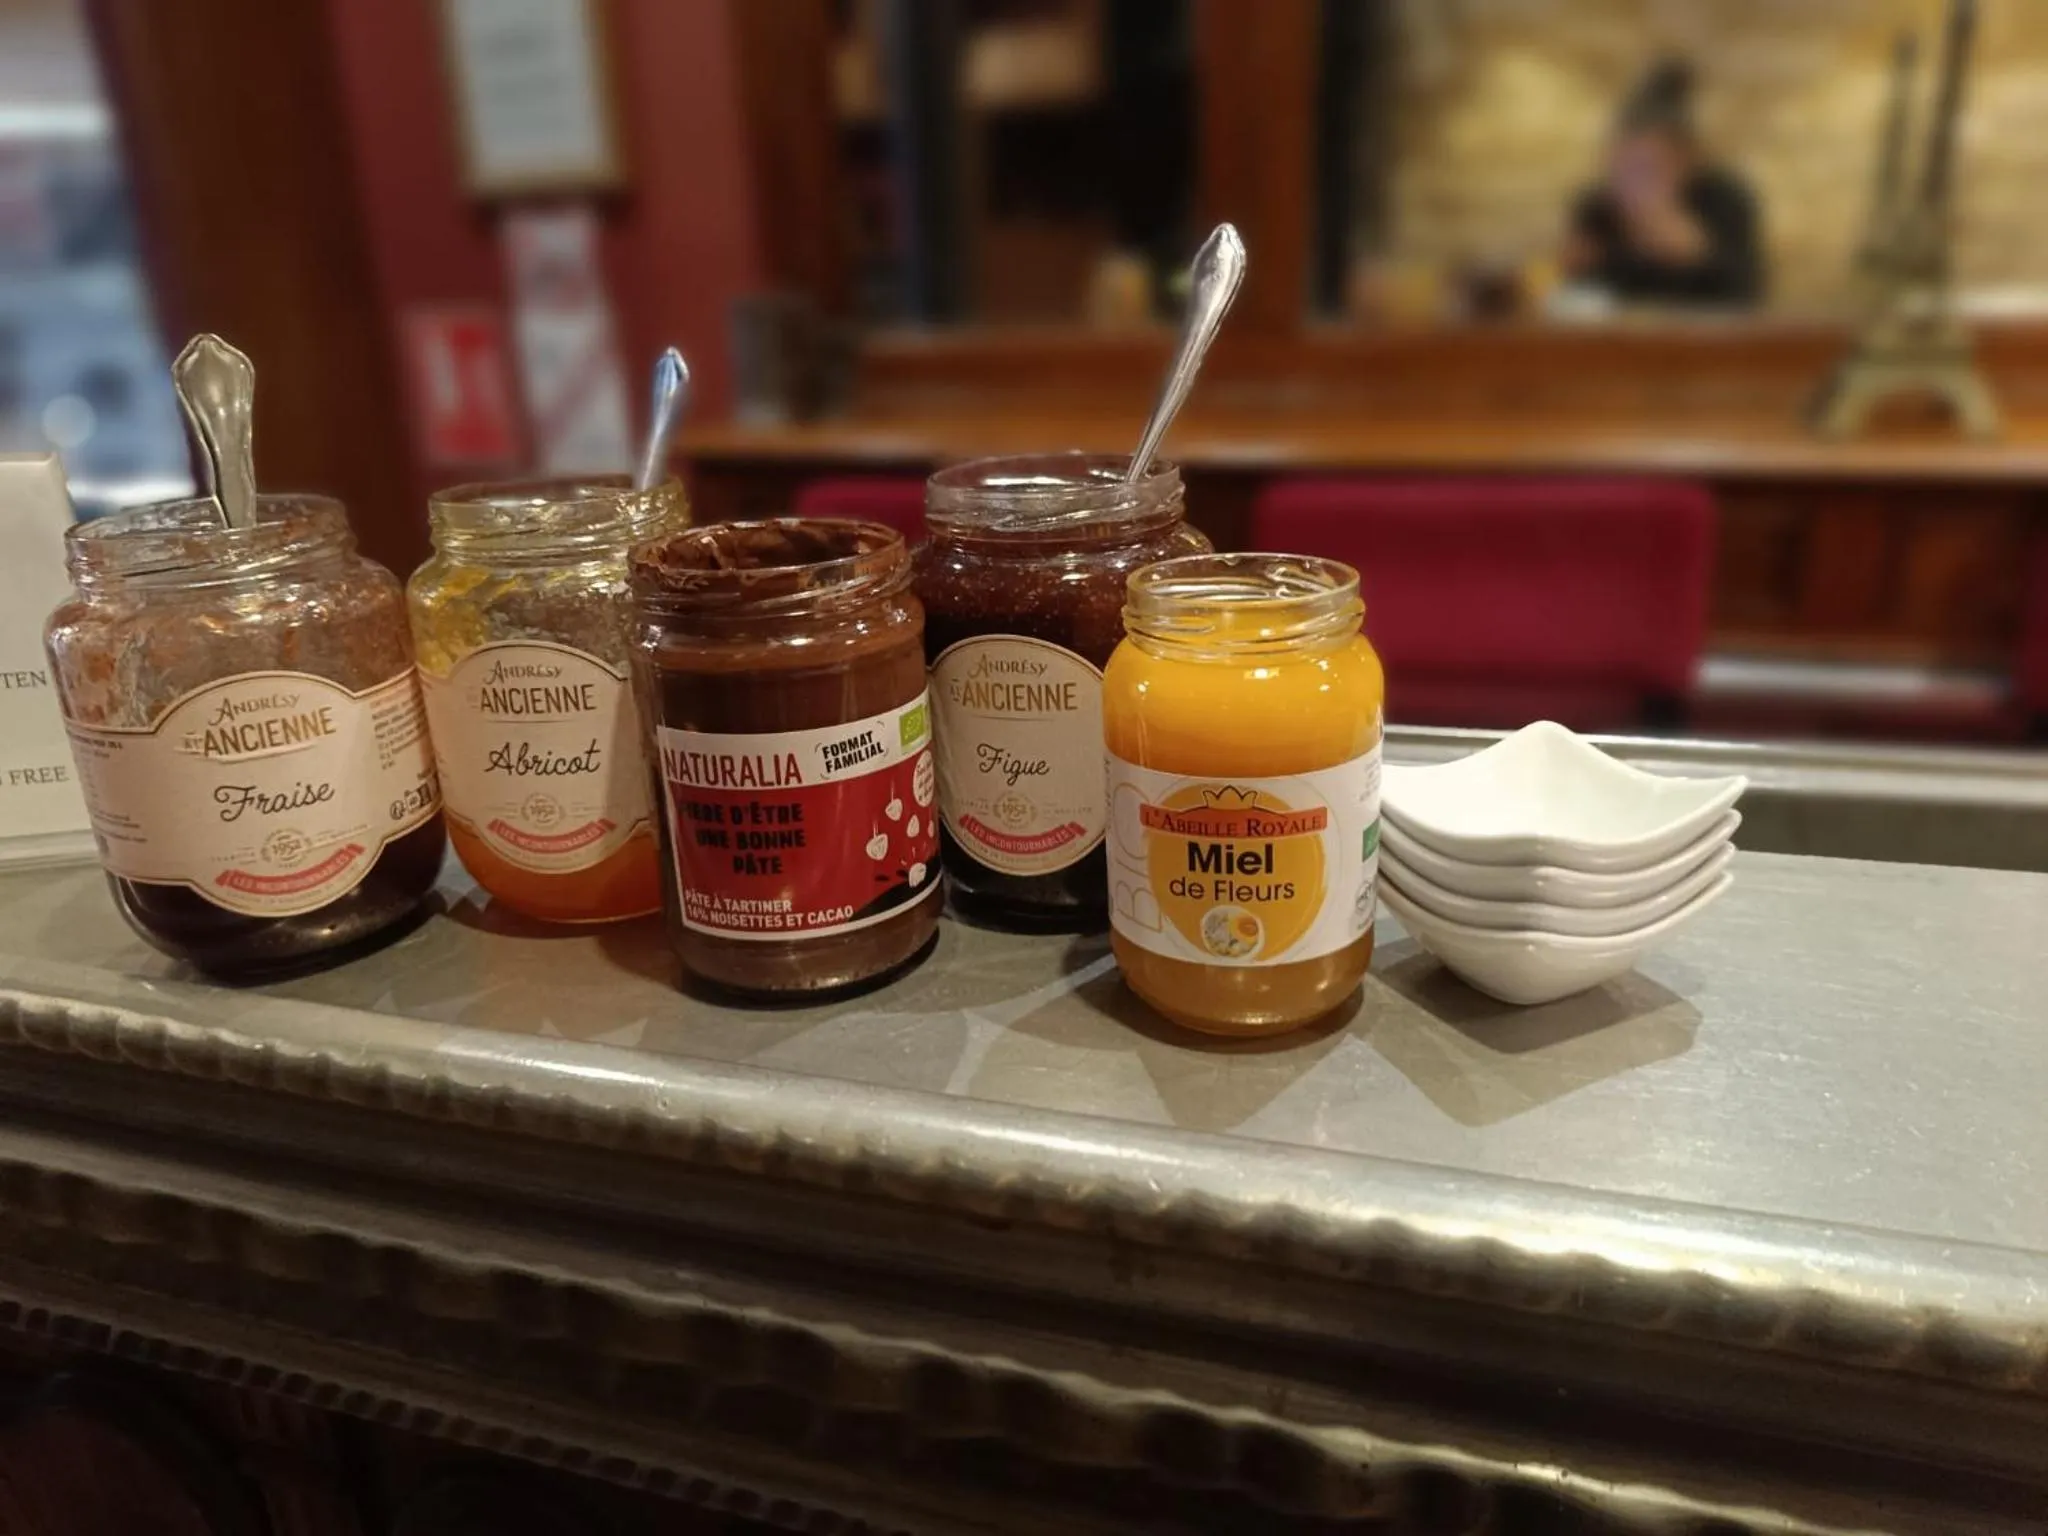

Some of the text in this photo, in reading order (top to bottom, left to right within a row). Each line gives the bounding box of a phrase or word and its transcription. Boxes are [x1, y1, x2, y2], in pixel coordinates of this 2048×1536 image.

[480, 684, 597, 715] ANCIENNE
[963, 682, 1078, 711] ANCIENNE
[203, 707, 338, 758] ANCIENNE
[822, 730, 874, 759] FORMAT
[484, 739, 603, 777] Abricot
[664, 749, 803, 787] NATURALIA
[825, 741, 885, 774] FAMILIAL
[976, 743, 1050, 785] Figue
[9, 765, 71, 786] FREE
[214, 780, 336, 822] Fraise
[1145, 809, 1322, 837] L'ABEILLE ROYALE
[696, 829, 807, 851] UNE BONNE
[733, 854, 783, 875] PÂTE
[1187, 840, 1274, 875] Miel
[685, 887, 793, 913] PÂTE À TARTINER
[1169, 876, 1296, 902] de Fleurs
[710, 911, 782, 928] NOISETTES
[786, 912, 803, 928] ET
[807, 904, 854, 925] CACAO
